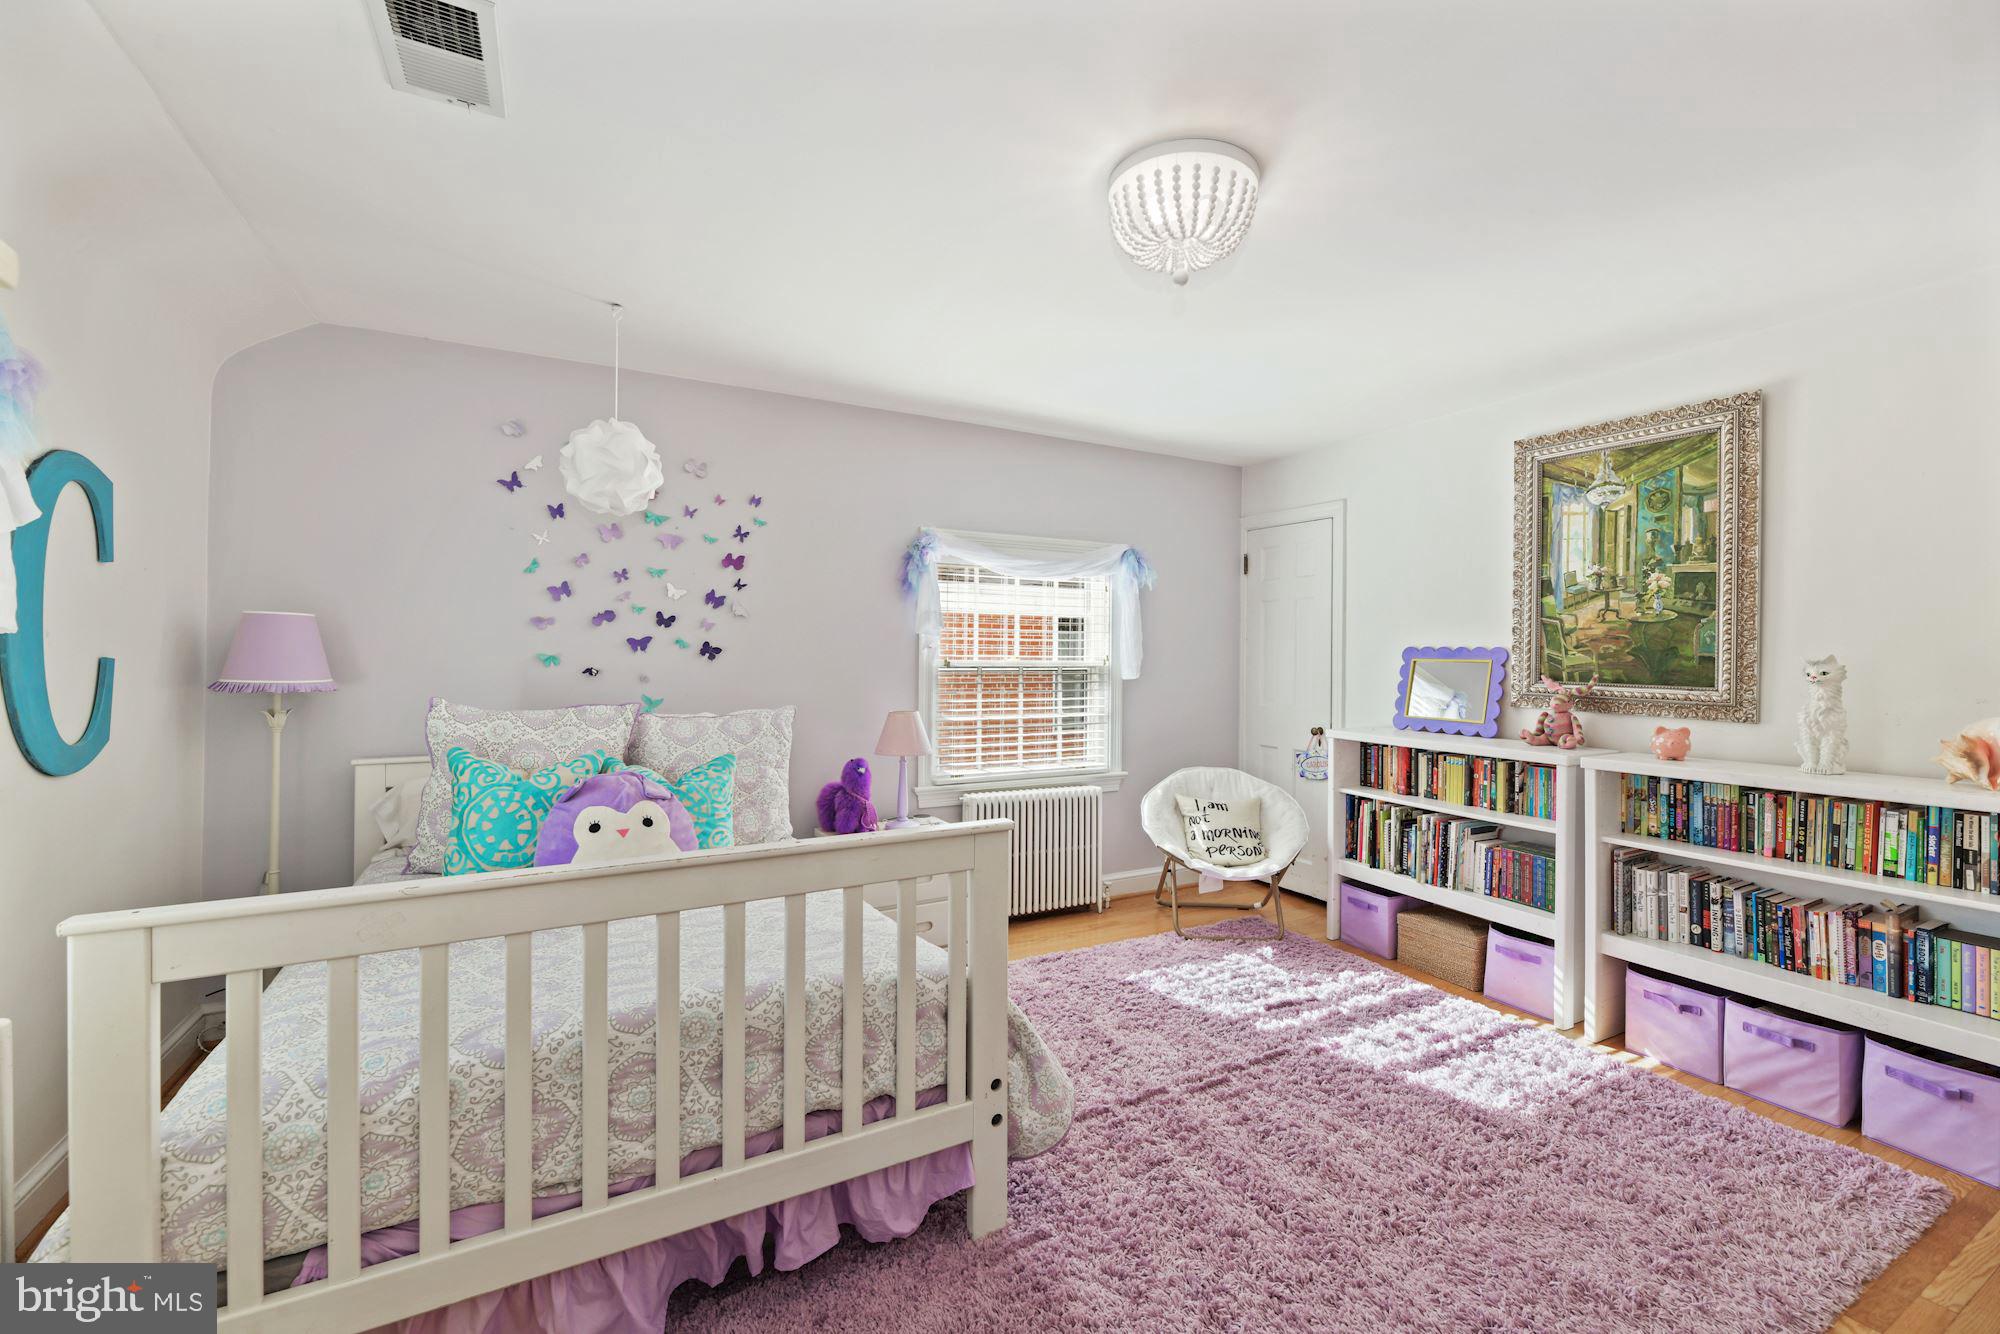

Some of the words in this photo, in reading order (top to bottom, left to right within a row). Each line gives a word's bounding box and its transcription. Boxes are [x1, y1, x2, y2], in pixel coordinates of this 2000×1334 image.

[0, 449, 115, 777] C
[1194, 798, 1200, 812] I
[1207, 801, 1229, 812] am
[1190, 830, 1196, 841] a
[1711, 909, 1719, 937] INKLING
[1735, 914, 1743, 946] OTHERWORLD
[1919, 947, 1927, 966] BOOK
